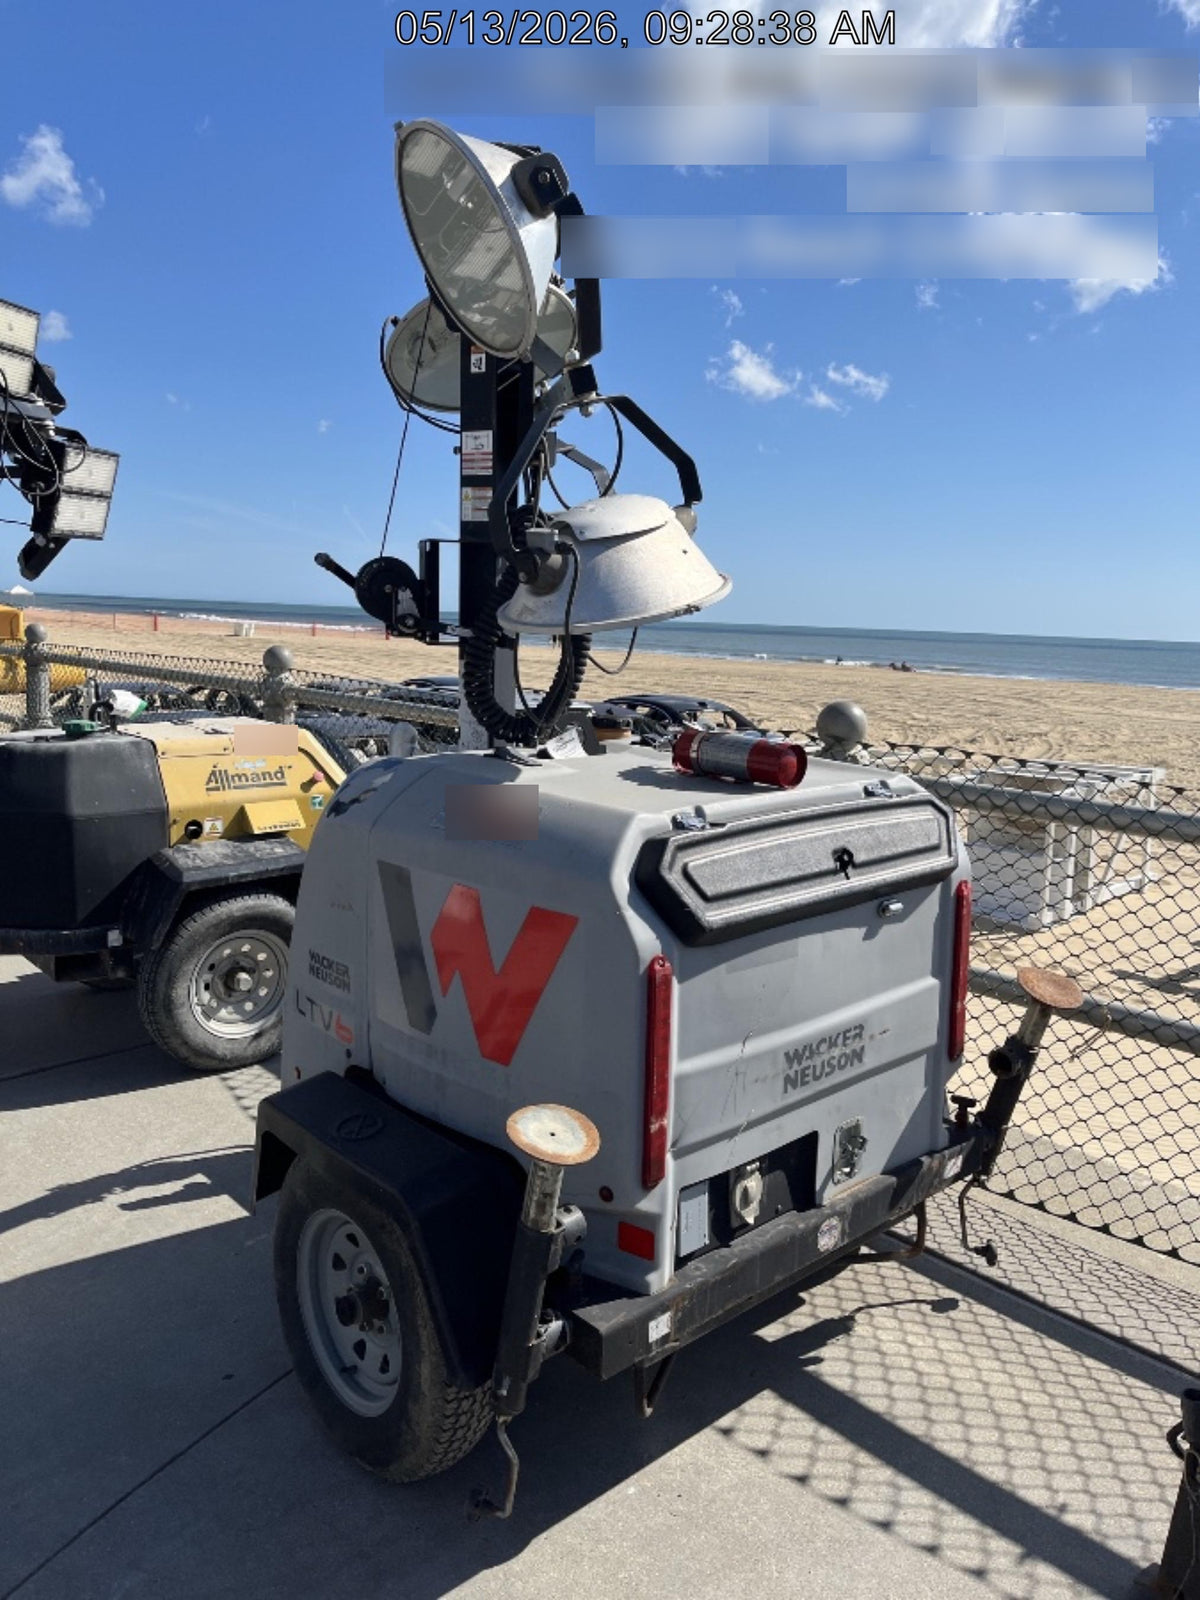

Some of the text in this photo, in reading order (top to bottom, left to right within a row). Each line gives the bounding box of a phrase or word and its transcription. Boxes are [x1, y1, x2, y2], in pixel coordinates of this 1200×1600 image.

[205, 766, 285, 791] Allmand
[309, 949, 350, 977] WACKER
[309, 962, 351, 994] NEUSON
[784, 1023, 865, 1070] WACKER
[784, 1045, 865, 1094] NEUSON
